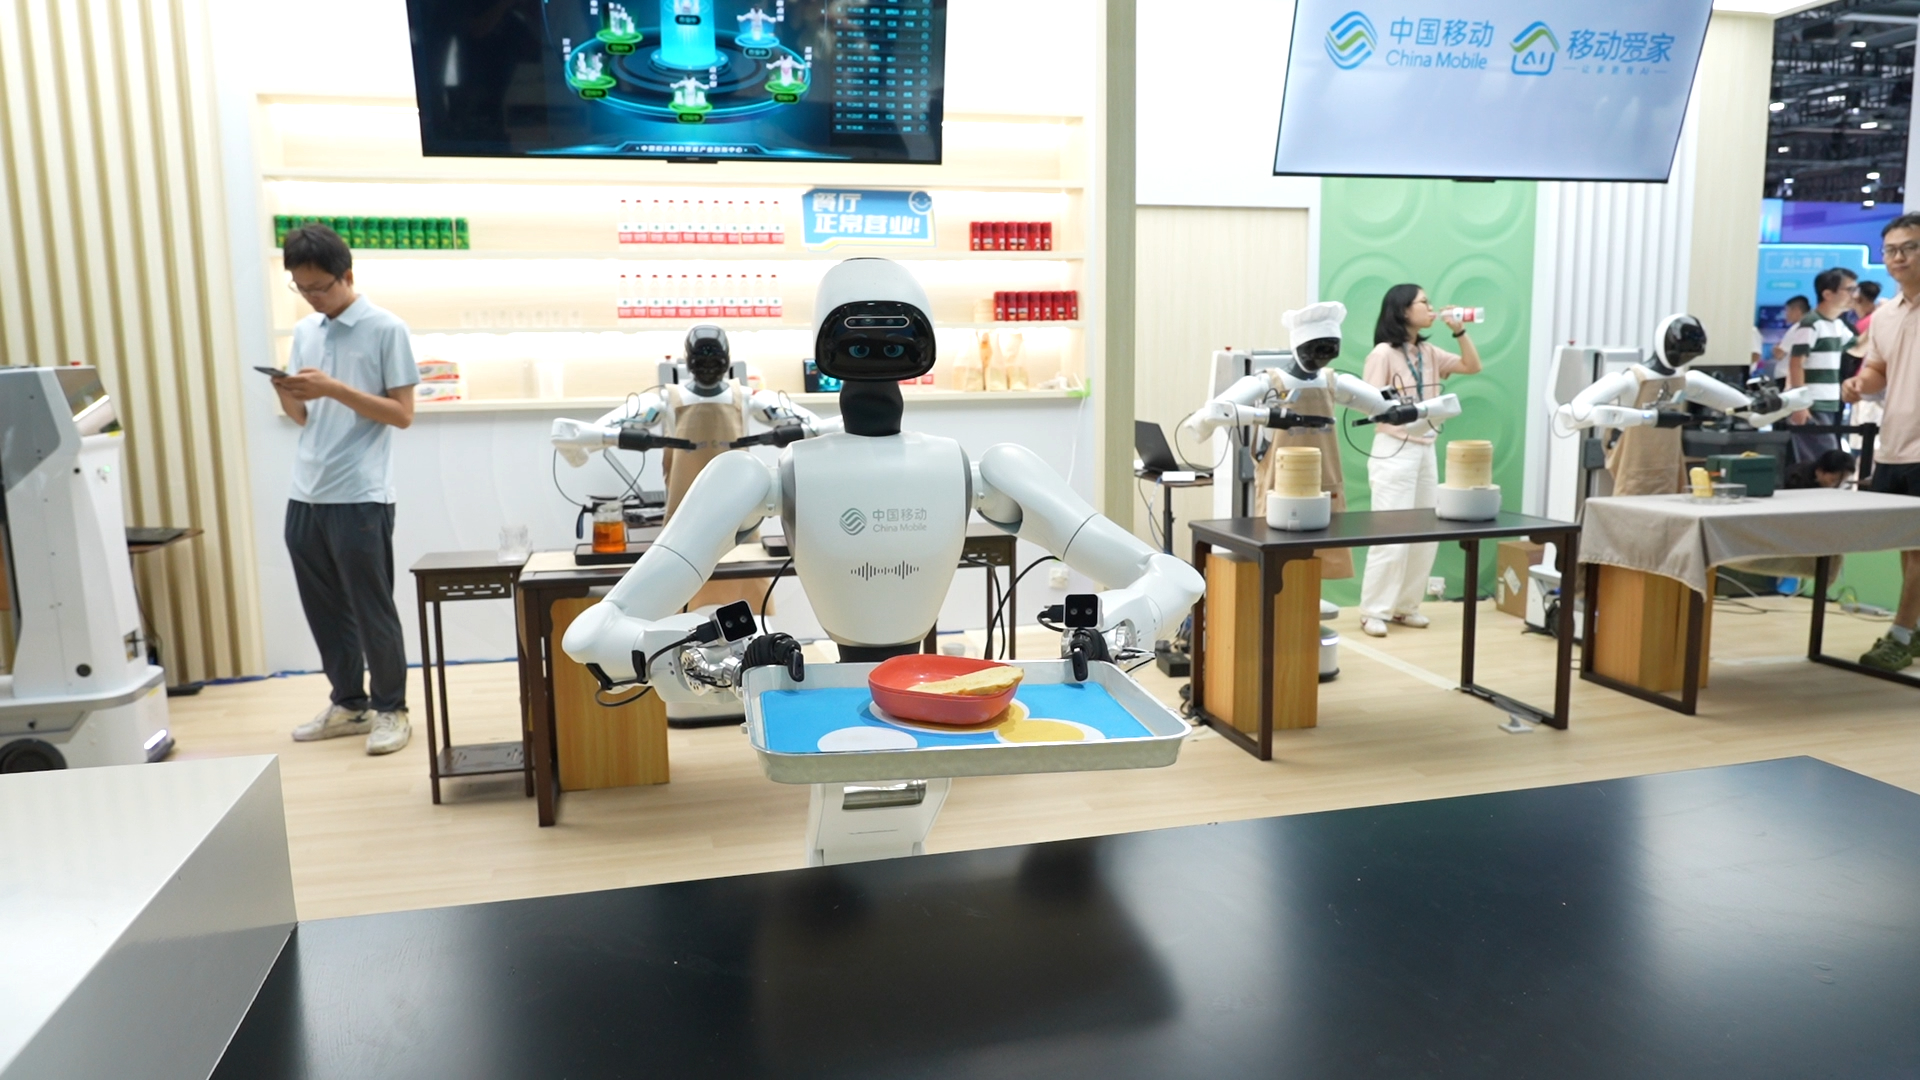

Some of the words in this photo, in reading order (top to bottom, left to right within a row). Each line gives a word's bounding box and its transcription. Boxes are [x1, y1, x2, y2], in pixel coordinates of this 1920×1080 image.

[1390, 16, 1494, 48] 中国移动
[1566, 29, 1675, 64] 移动爱家
[1385, 49, 1431, 68] China
[1435, 52, 1488, 70] Mobile
[812, 192, 862, 213] 餐厅
[872, 508, 927, 522] 中国移动
[872, 523, 898, 533] China
[899, 523, 927, 532] Mobile
